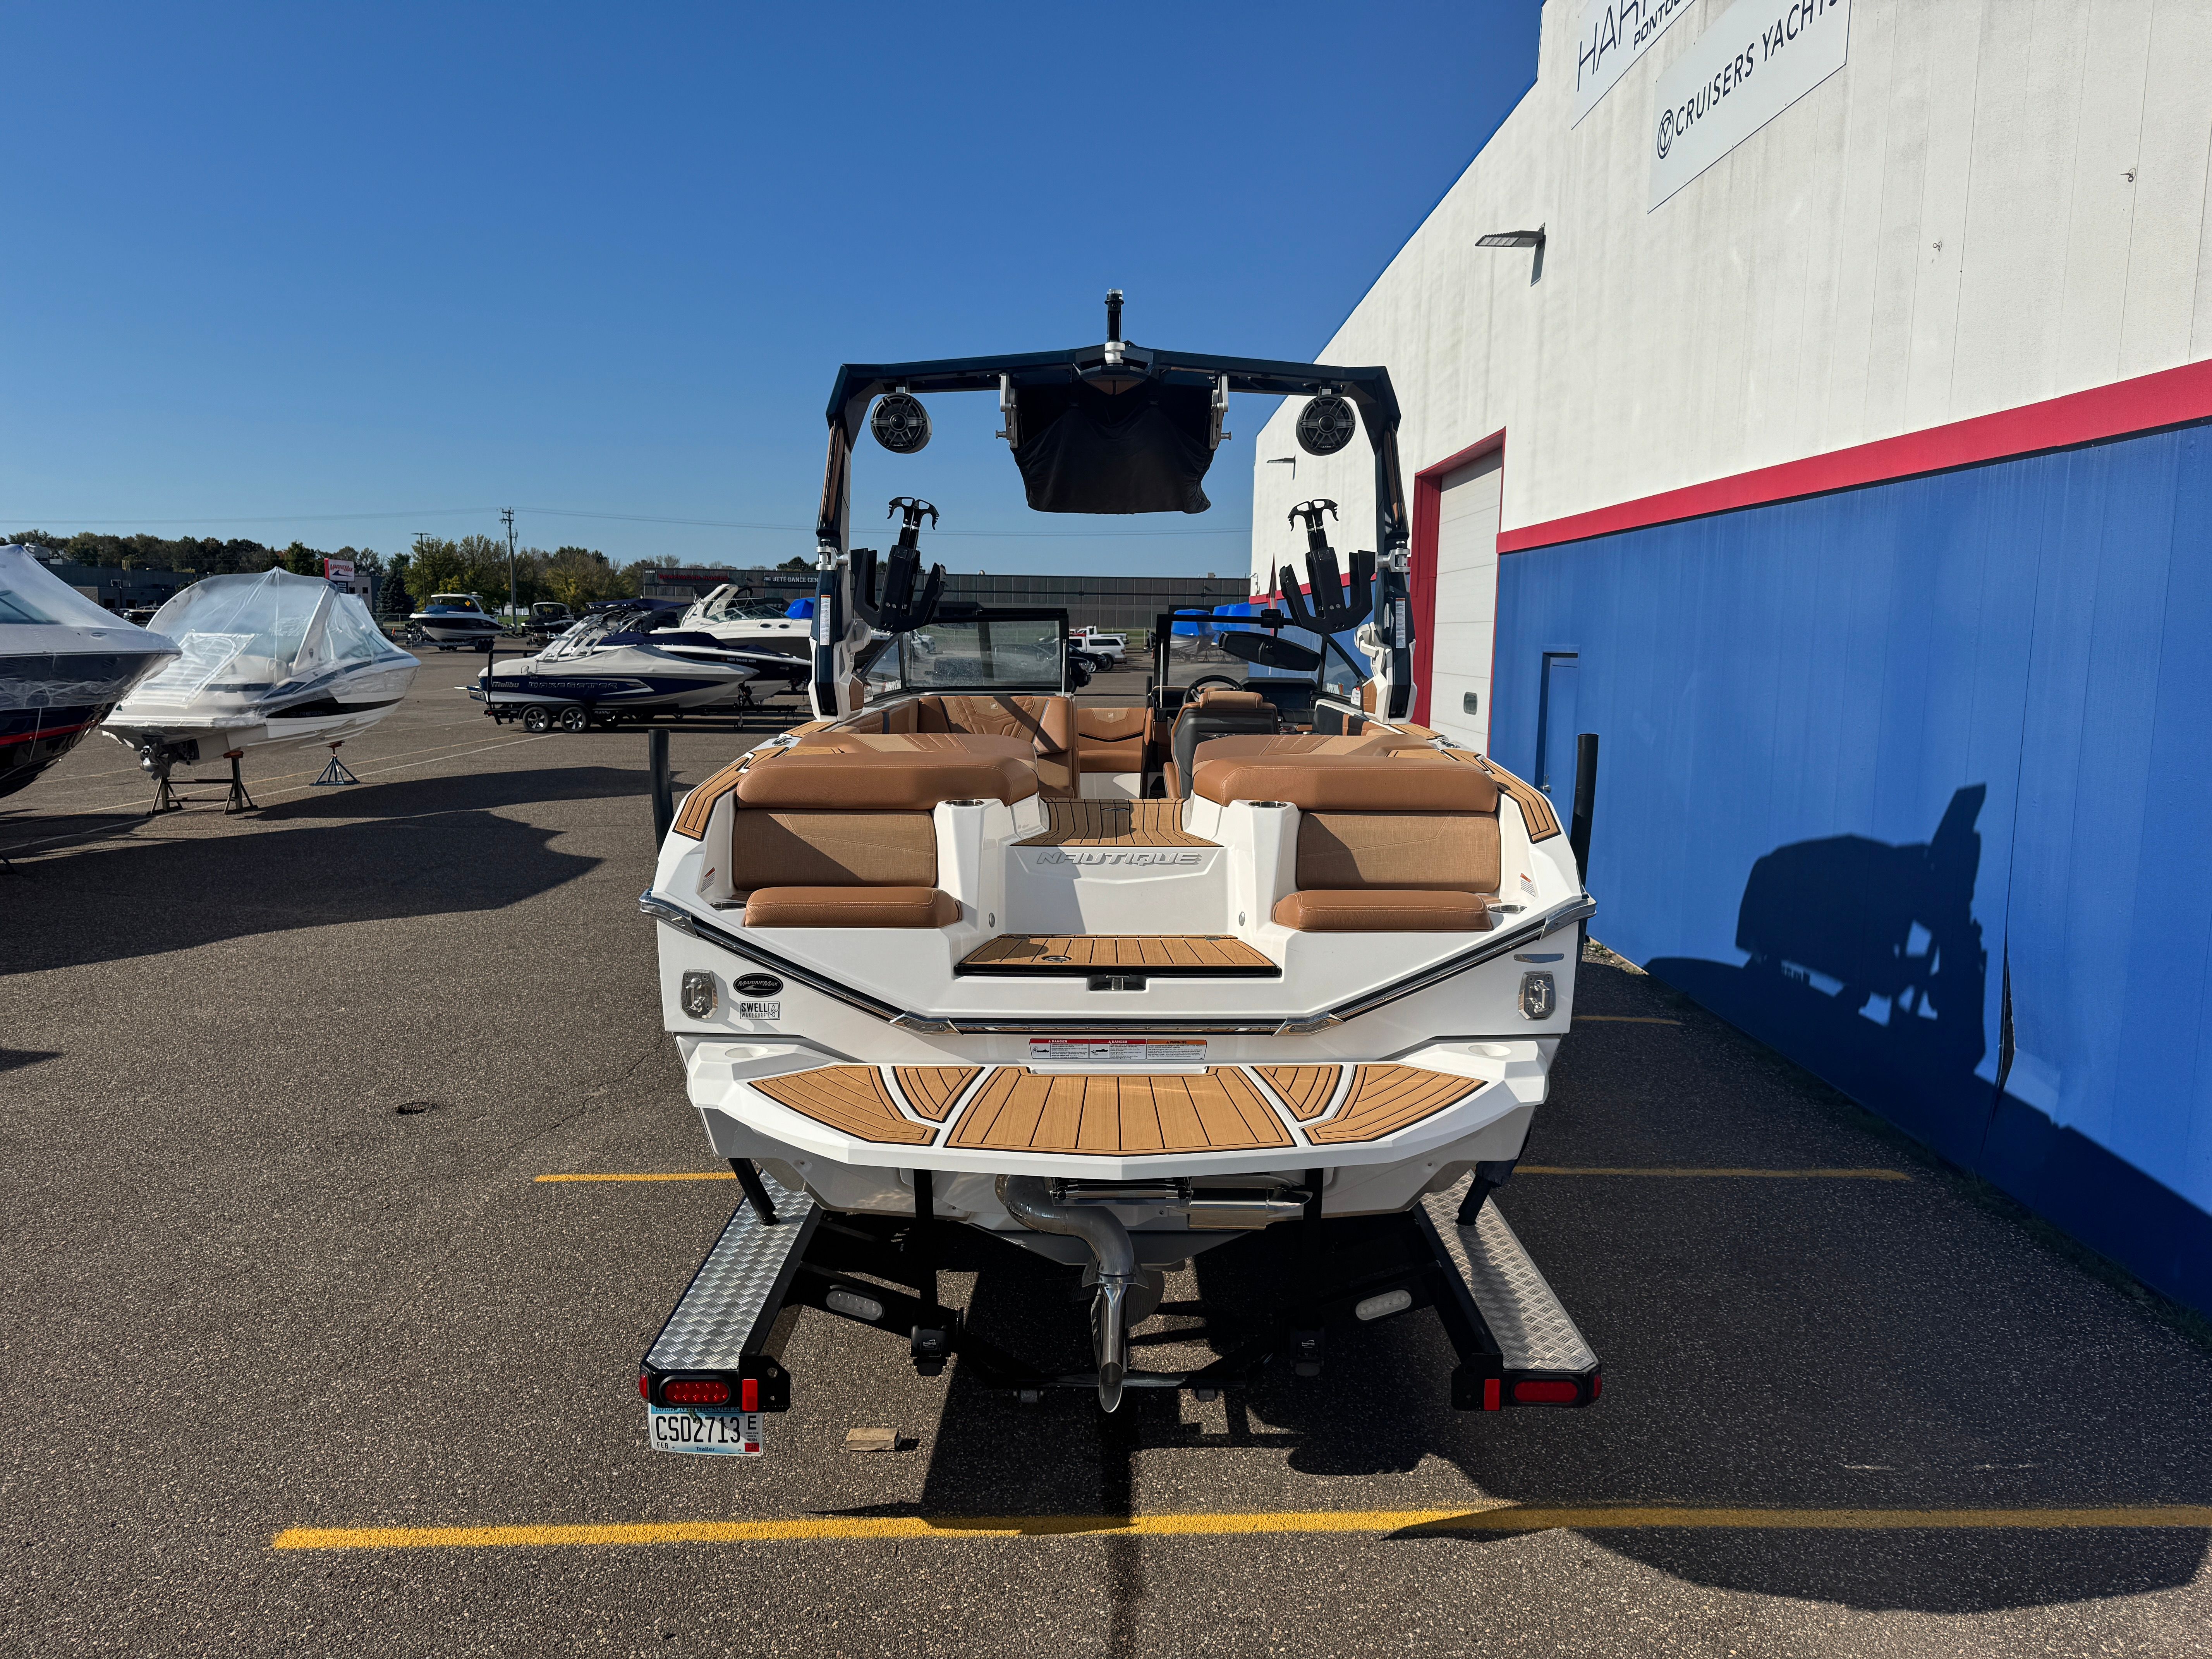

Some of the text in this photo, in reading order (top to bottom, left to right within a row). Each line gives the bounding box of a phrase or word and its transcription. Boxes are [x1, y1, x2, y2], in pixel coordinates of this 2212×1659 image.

[1676, 43, 1755, 136] CRUISERS
[1037, 852, 1202, 866] NAUTIQUE
[741, 1002, 768, 1012] SWELL
[656, 1416, 740, 1443] CSD2713
[747, 1415, 757, 1430] E
